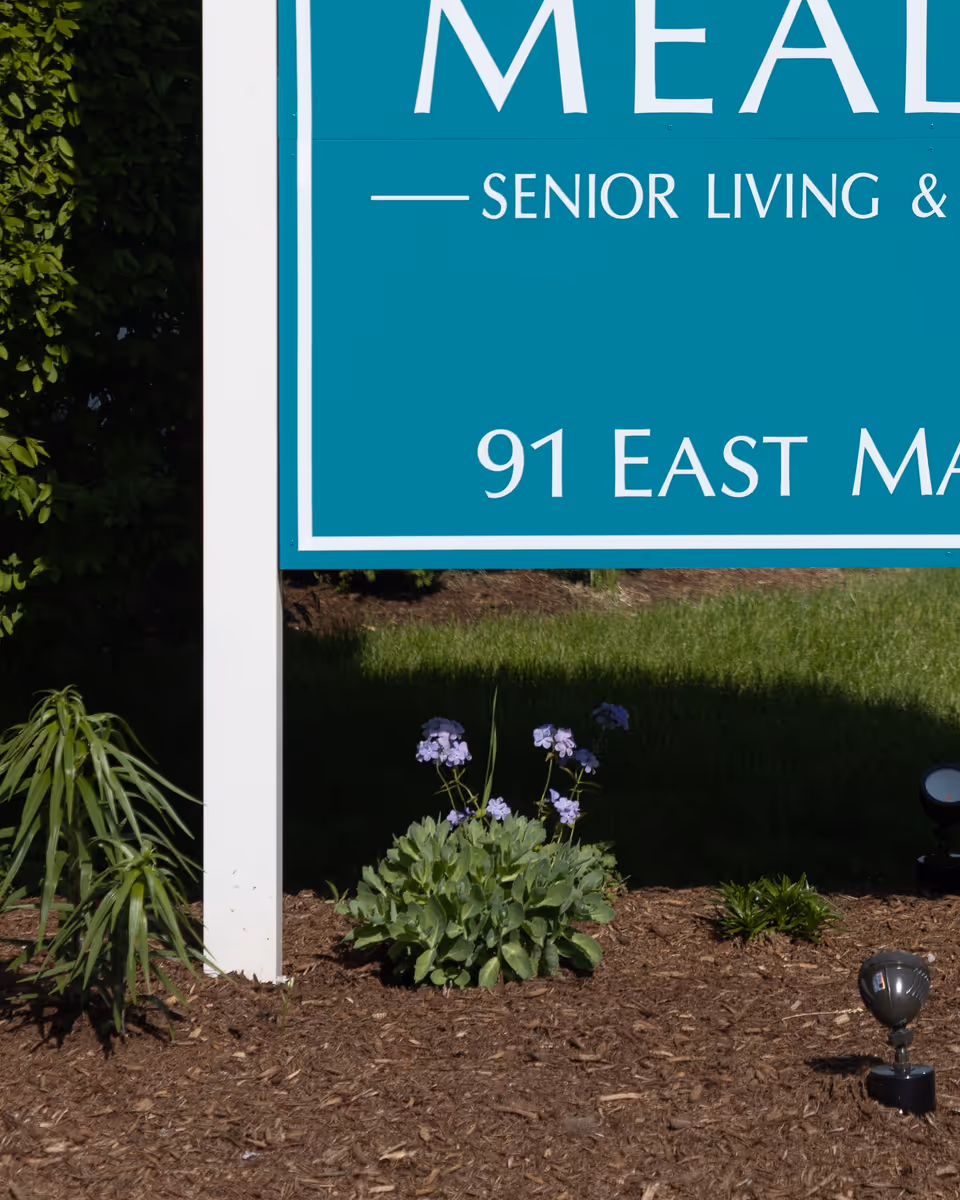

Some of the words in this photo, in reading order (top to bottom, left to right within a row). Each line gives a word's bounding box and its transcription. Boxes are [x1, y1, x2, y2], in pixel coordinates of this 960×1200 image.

[481, 172, 679, 220] SENIOR
[707, 172, 880, 220] LIVING
[911, 173, 948, 218] &
[476, 428, 563, 499] 91
[614, 428, 808, 499] EAST
